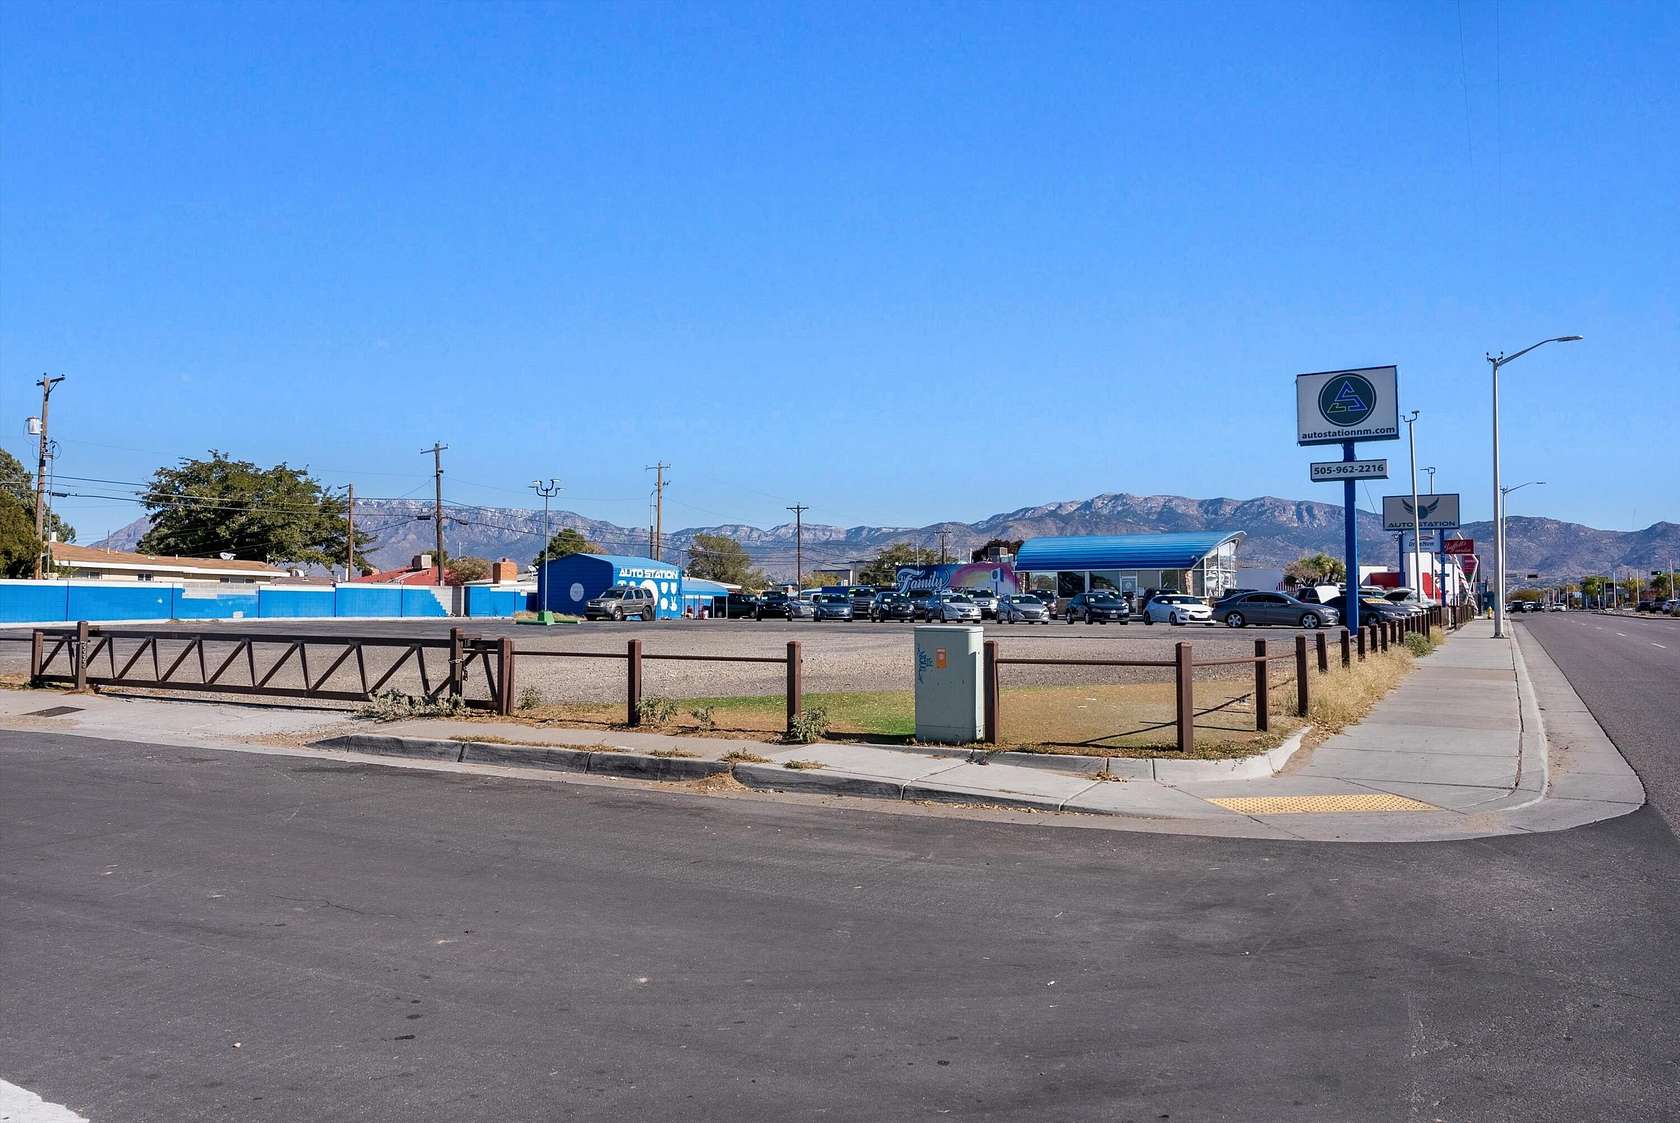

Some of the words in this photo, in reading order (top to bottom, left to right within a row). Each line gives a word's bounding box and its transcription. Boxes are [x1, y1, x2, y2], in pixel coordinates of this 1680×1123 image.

[1302, 427, 1395, 439] autostationnm.com
[1314, 464, 1384, 475] 505-962-2216
[619, 568, 643, 577] AUTO
[644, 569, 678, 579] STATION
[896, 568, 950, 594] Family
